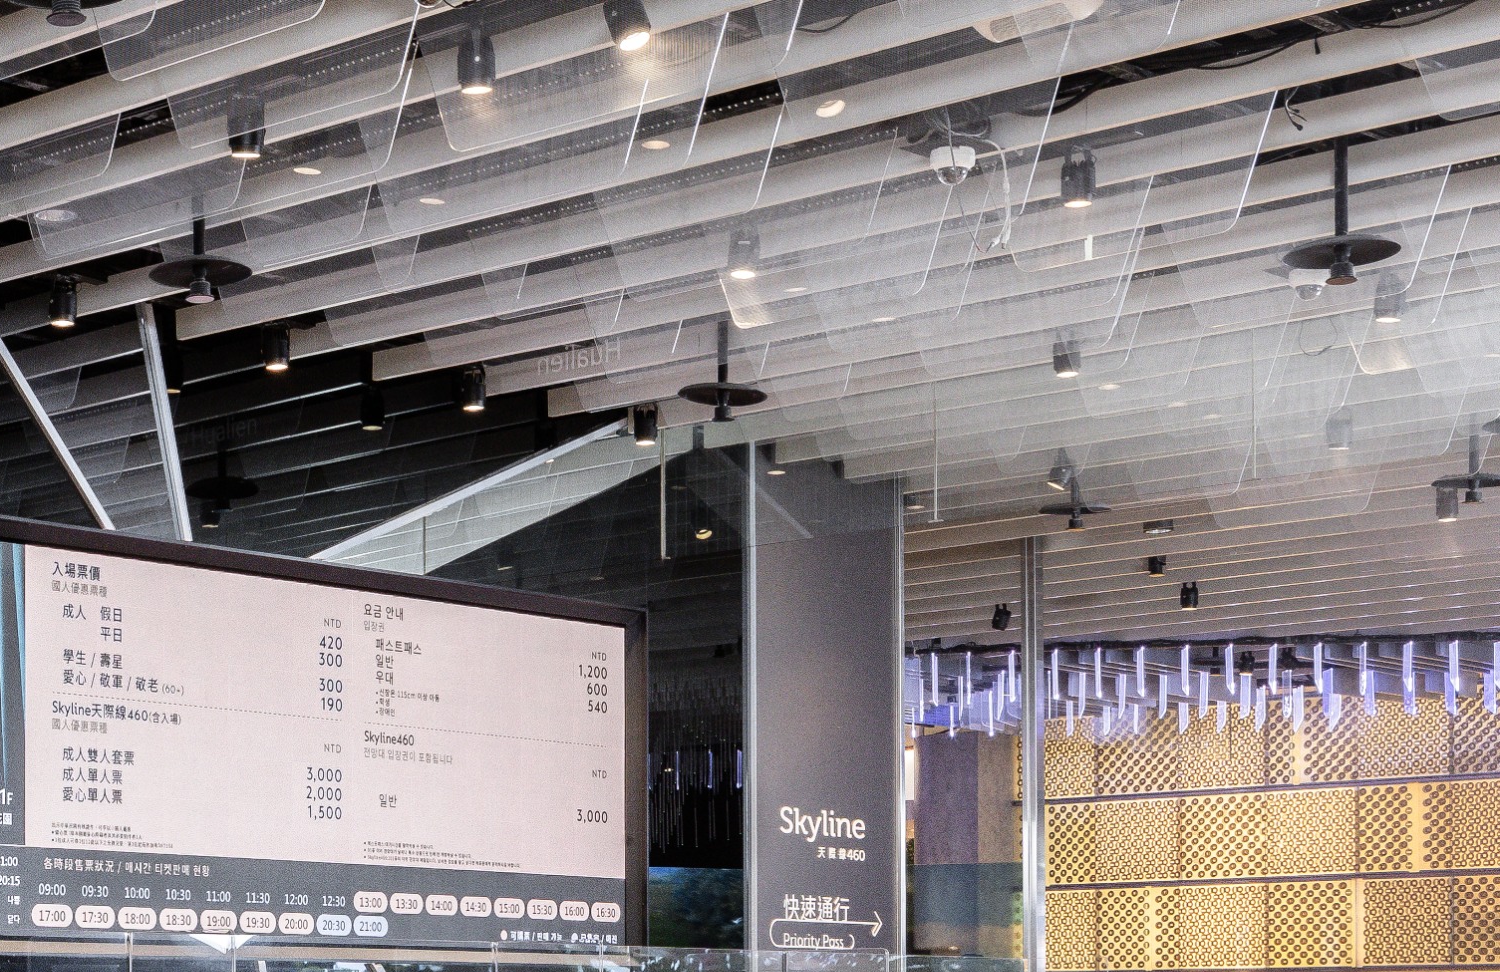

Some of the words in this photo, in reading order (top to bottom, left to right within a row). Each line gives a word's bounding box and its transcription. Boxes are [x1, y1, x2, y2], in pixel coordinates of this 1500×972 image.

[52, 561, 101, 582] 入場票價
[62, 603, 87, 621] 成人
[100, 605, 123, 623] 假日
[364, 603, 382, 619] 요금
[385, 606, 404, 621] 안내
[323, 618, 342, 629] NTD
[100, 626, 123, 643] 平日
[319, 635, 343, 651] 420
[375, 638, 422, 656] 패스트패스
[63, 648, 87, 666] 學生
[100, 653, 123, 670] 壽星
[318, 652, 343, 668] 300
[375, 654, 394, 670] 일반
[591, 651, 607, 662] NTD
[375, 670, 394, 686] 우대
[578, 664, 608, 681] 1,200
[63, 669, 87, 687] 愛心
[100, 672, 123, 690] 敬軍
[135, 676, 159, 694] 敬老
[318, 677, 343, 693] 300
[587, 682, 608, 697] 600
[320, 697, 343, 713] 190
[587, 700, 608, 714] 540
[363, 730, 415, 747] Skyline460
[62, 746, 135, 766] 成人雙人套票
[323, 743, 342, 754] NTD
[62, 766, 123, 786] 成人單人票
[306, 766, 343, 783] 3,000
[591, 769, 608, 779] NTD
[62, 786, 123, 805] 愛心單人票
[306, 785, 343, 802] 2,000
[379, 793, 397, 808] 일반
[307, 804, 343, 821] 1,500
[576, 808, 608, 824] 3,000
[779, 806, 866, 843] Skyline
[43, 856, 115, 874] 各時段售票狀況
[38, 883, 66, 897] 09:00
[81, 884, 109, 898] 09:30
[124, 886, 151, 900] 10:00
[165, 888, 192, 902] 10:30
[205, 890, 231, 903] 11:00
[245, 891, 271, 905] 11:30
[284, 893, 309, 906] 12:00
[322, 895, 346, 908] 12:30
[359, 896, 383, 909] 13:00
[395, 898, 418, 910] 13:30
[430, 900, 453, 912] 14:00
[465, 901, 487, 913] 14:30
[498, 903, 521, 915] 15:00
[531, 904, 553, 916] 15:30
[564, 905, 585, 917] 16:00
[596, 907, 616, 918] 16:30
[783, 893, 850, 922] 快速通行
[38, 910, 66, 922] 17:00
[81, 911, 109, 924] 17:30
[124, 912, 151, 925] 18:00
[165, 914, 192, 927] 18:30
[205, 915, 231, 928] 19:00
[245, 916, 271, 929] 19:30
[284, 918, 309, 930] 20:00
[322, 919, 346, 932] 20:30
[359, 920, 383, 933] 21:00
[783, 932, 821, 951] Priority
[822, 933, 844, 949] Pass
